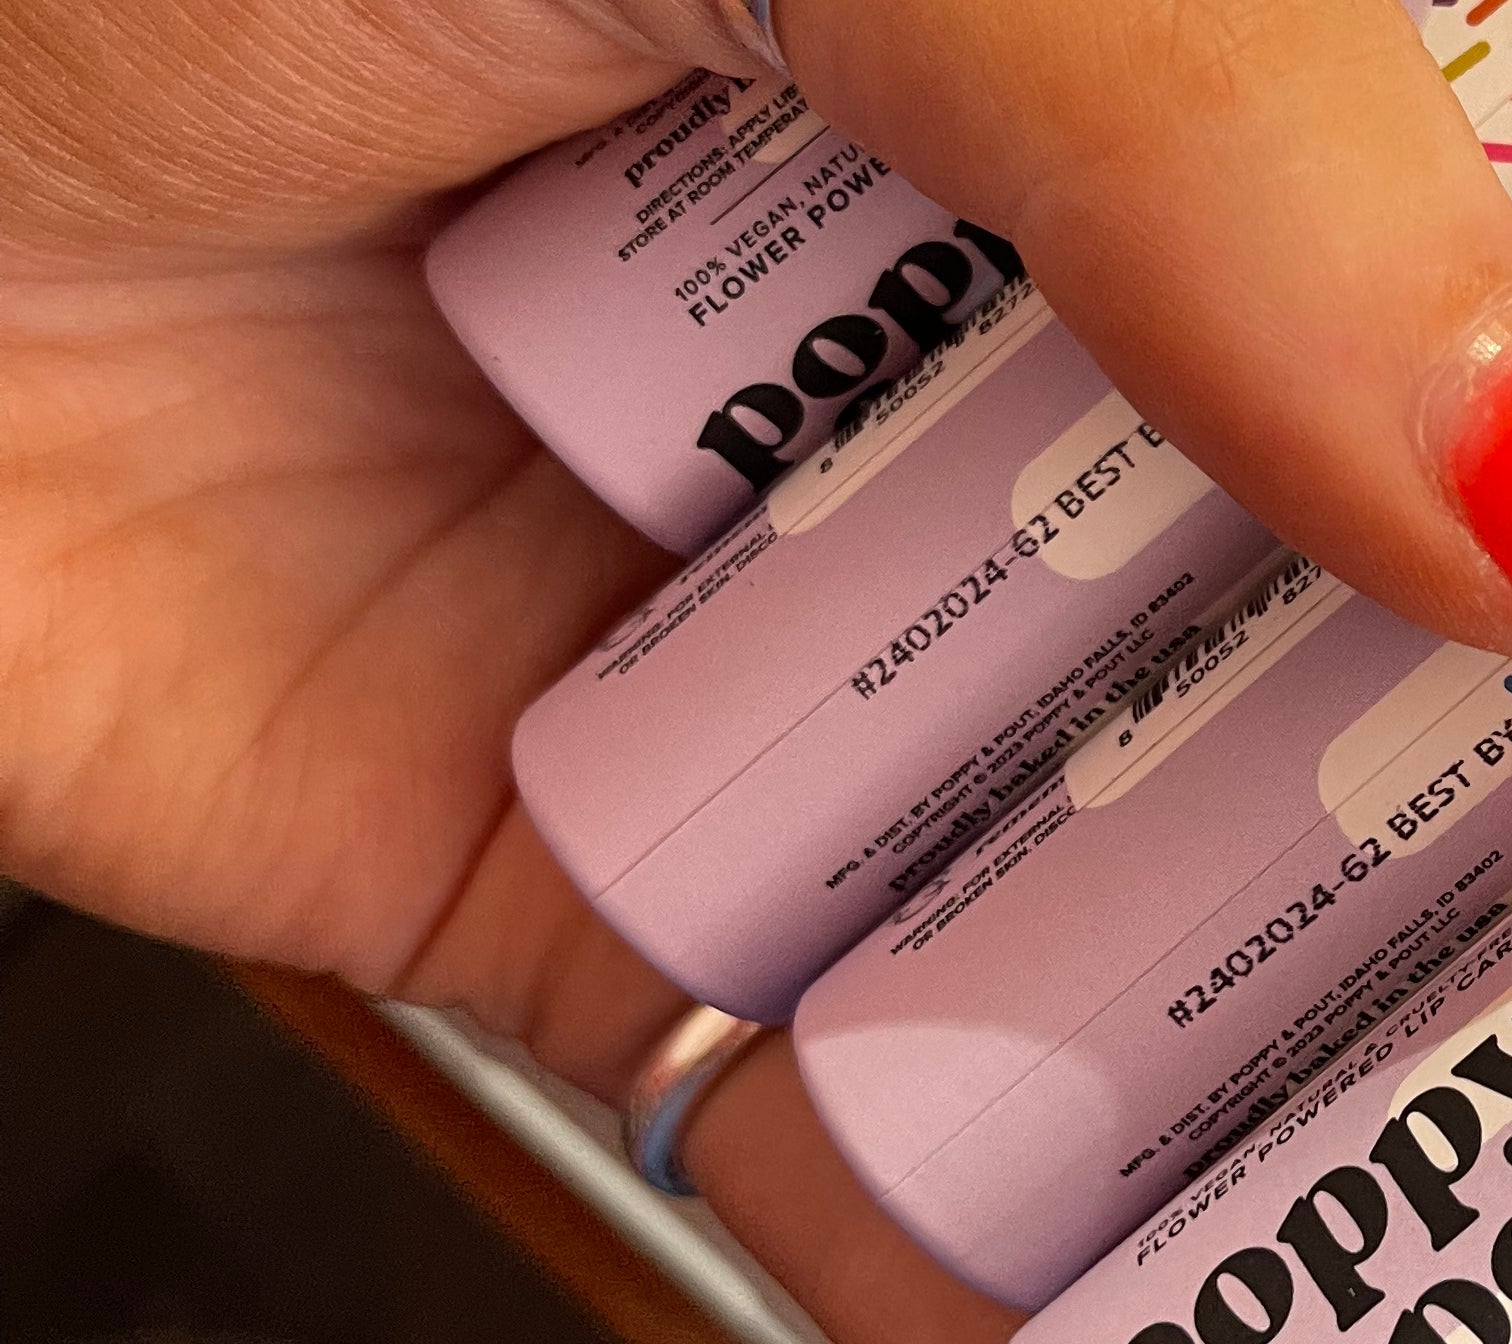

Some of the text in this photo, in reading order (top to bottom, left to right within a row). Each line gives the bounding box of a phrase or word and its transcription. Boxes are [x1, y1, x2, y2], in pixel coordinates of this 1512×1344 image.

[616, 216, 669, 263] STORE
[686, 160, 736, 205] ROOM
[732, 96, 810, 166] TEMPERAT
[625, 79, 730, 188] proudly
[727, 104, 772, 149] APPLY
[674, 141, 865, 302] 100% VEGAN, NATU
[687, 154, 891, 327] FLOWER POWE
[849, 512, 1062, 701] #2402024-62
[1052, 439, 1138, 520] BEST
[930, 754, 980, 800] POPPY
[1036, 666, 1085, 709] IDAHO
[988, 726, 1076, 803] baked
[1069, 704, 1106, 733] in
[1102, 664, 1152, 705] the
[1022, 697, 1072, 743] POPPY
[1084, 650, 1127, 689] POUT
[1125, 627, 1155, 655] LLC
[1175, 629, 1250, 698] 50052
[934, 876, 994, 932] BROKEN
[962, 866, 991, 894] FOR
[992, 803, 1065, 867] EXTERNAL
[1166, 835, 1392, 1030] #2402024-62
[1386, 758, 1474, 841] BEST
[1187, 1067, 1272, 1142] COPYRIGHT
[1323, 979, 1374, 1026] POPPY
[1388, 930, 1431, 970] POUT
[1430, 907, 1461, 934] LLC
[1228, 1038, 1280, 1085] POPPY
[1293, 988, 1342, 1030] POUT,
[1338, 947, 1389, 992] IDAHO
[1386, 907, 1439, 950] FALLS,
[1454, 849, 1505, 893] 83402
[1287, 1009, 1377, 1085] baked
[1372, 986, 1408, 1014] in
[1405, 943, 1455, 985] the
[1455, 901, 1509, 943] usa
[1135, 1165, 1248, 1267] FLOWER
[1257, 1041, 1395, 1163] POWERED
[1403, 996, 1446, 1038] LIP
[1269, 1060, 1357, 1136] NATURAL
